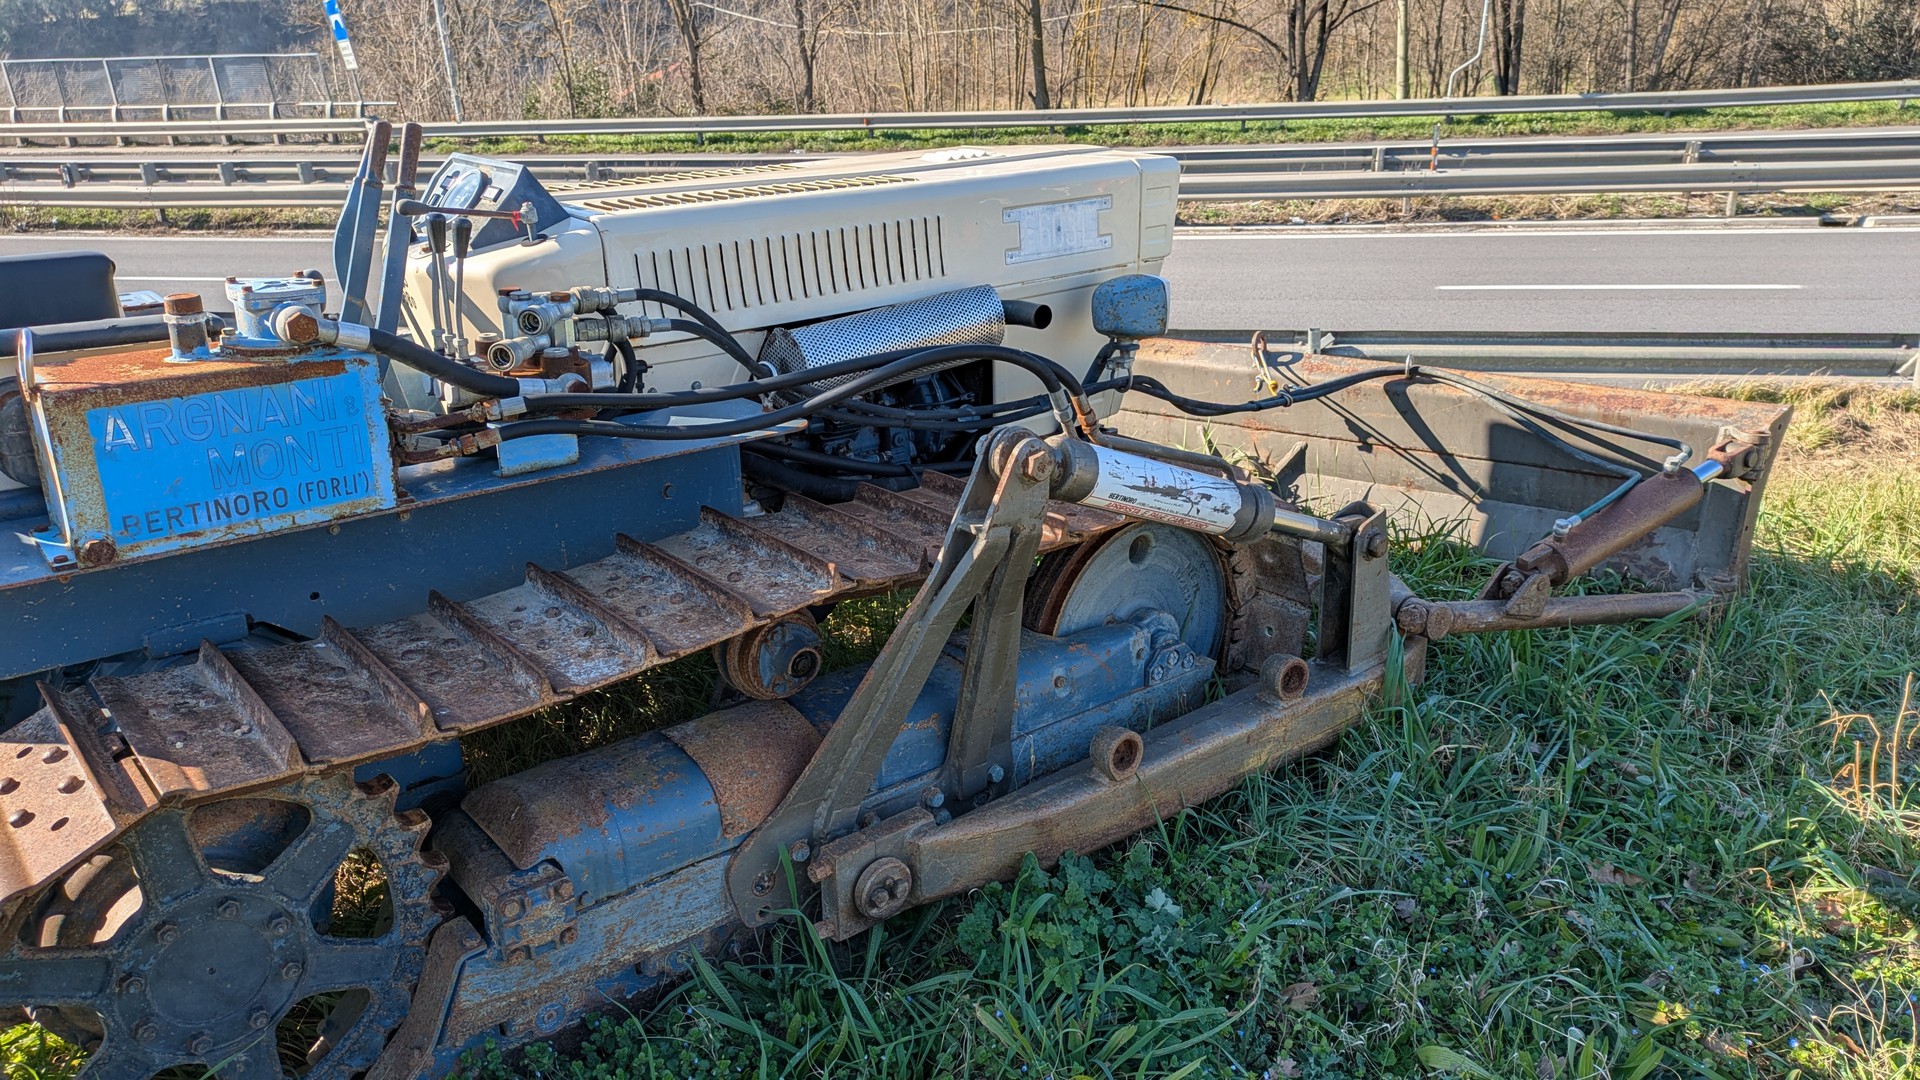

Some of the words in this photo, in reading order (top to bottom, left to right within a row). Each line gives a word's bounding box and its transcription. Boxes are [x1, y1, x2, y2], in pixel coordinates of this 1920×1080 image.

[103, 378, 337, 454] ARGNANI
[343, 396, 360, 417] &
[207, 424, 366, 491] MONTI
[122, 486, 289, 538] BERTINORO
[1108, 492, 1138, 505] BERTINORO
